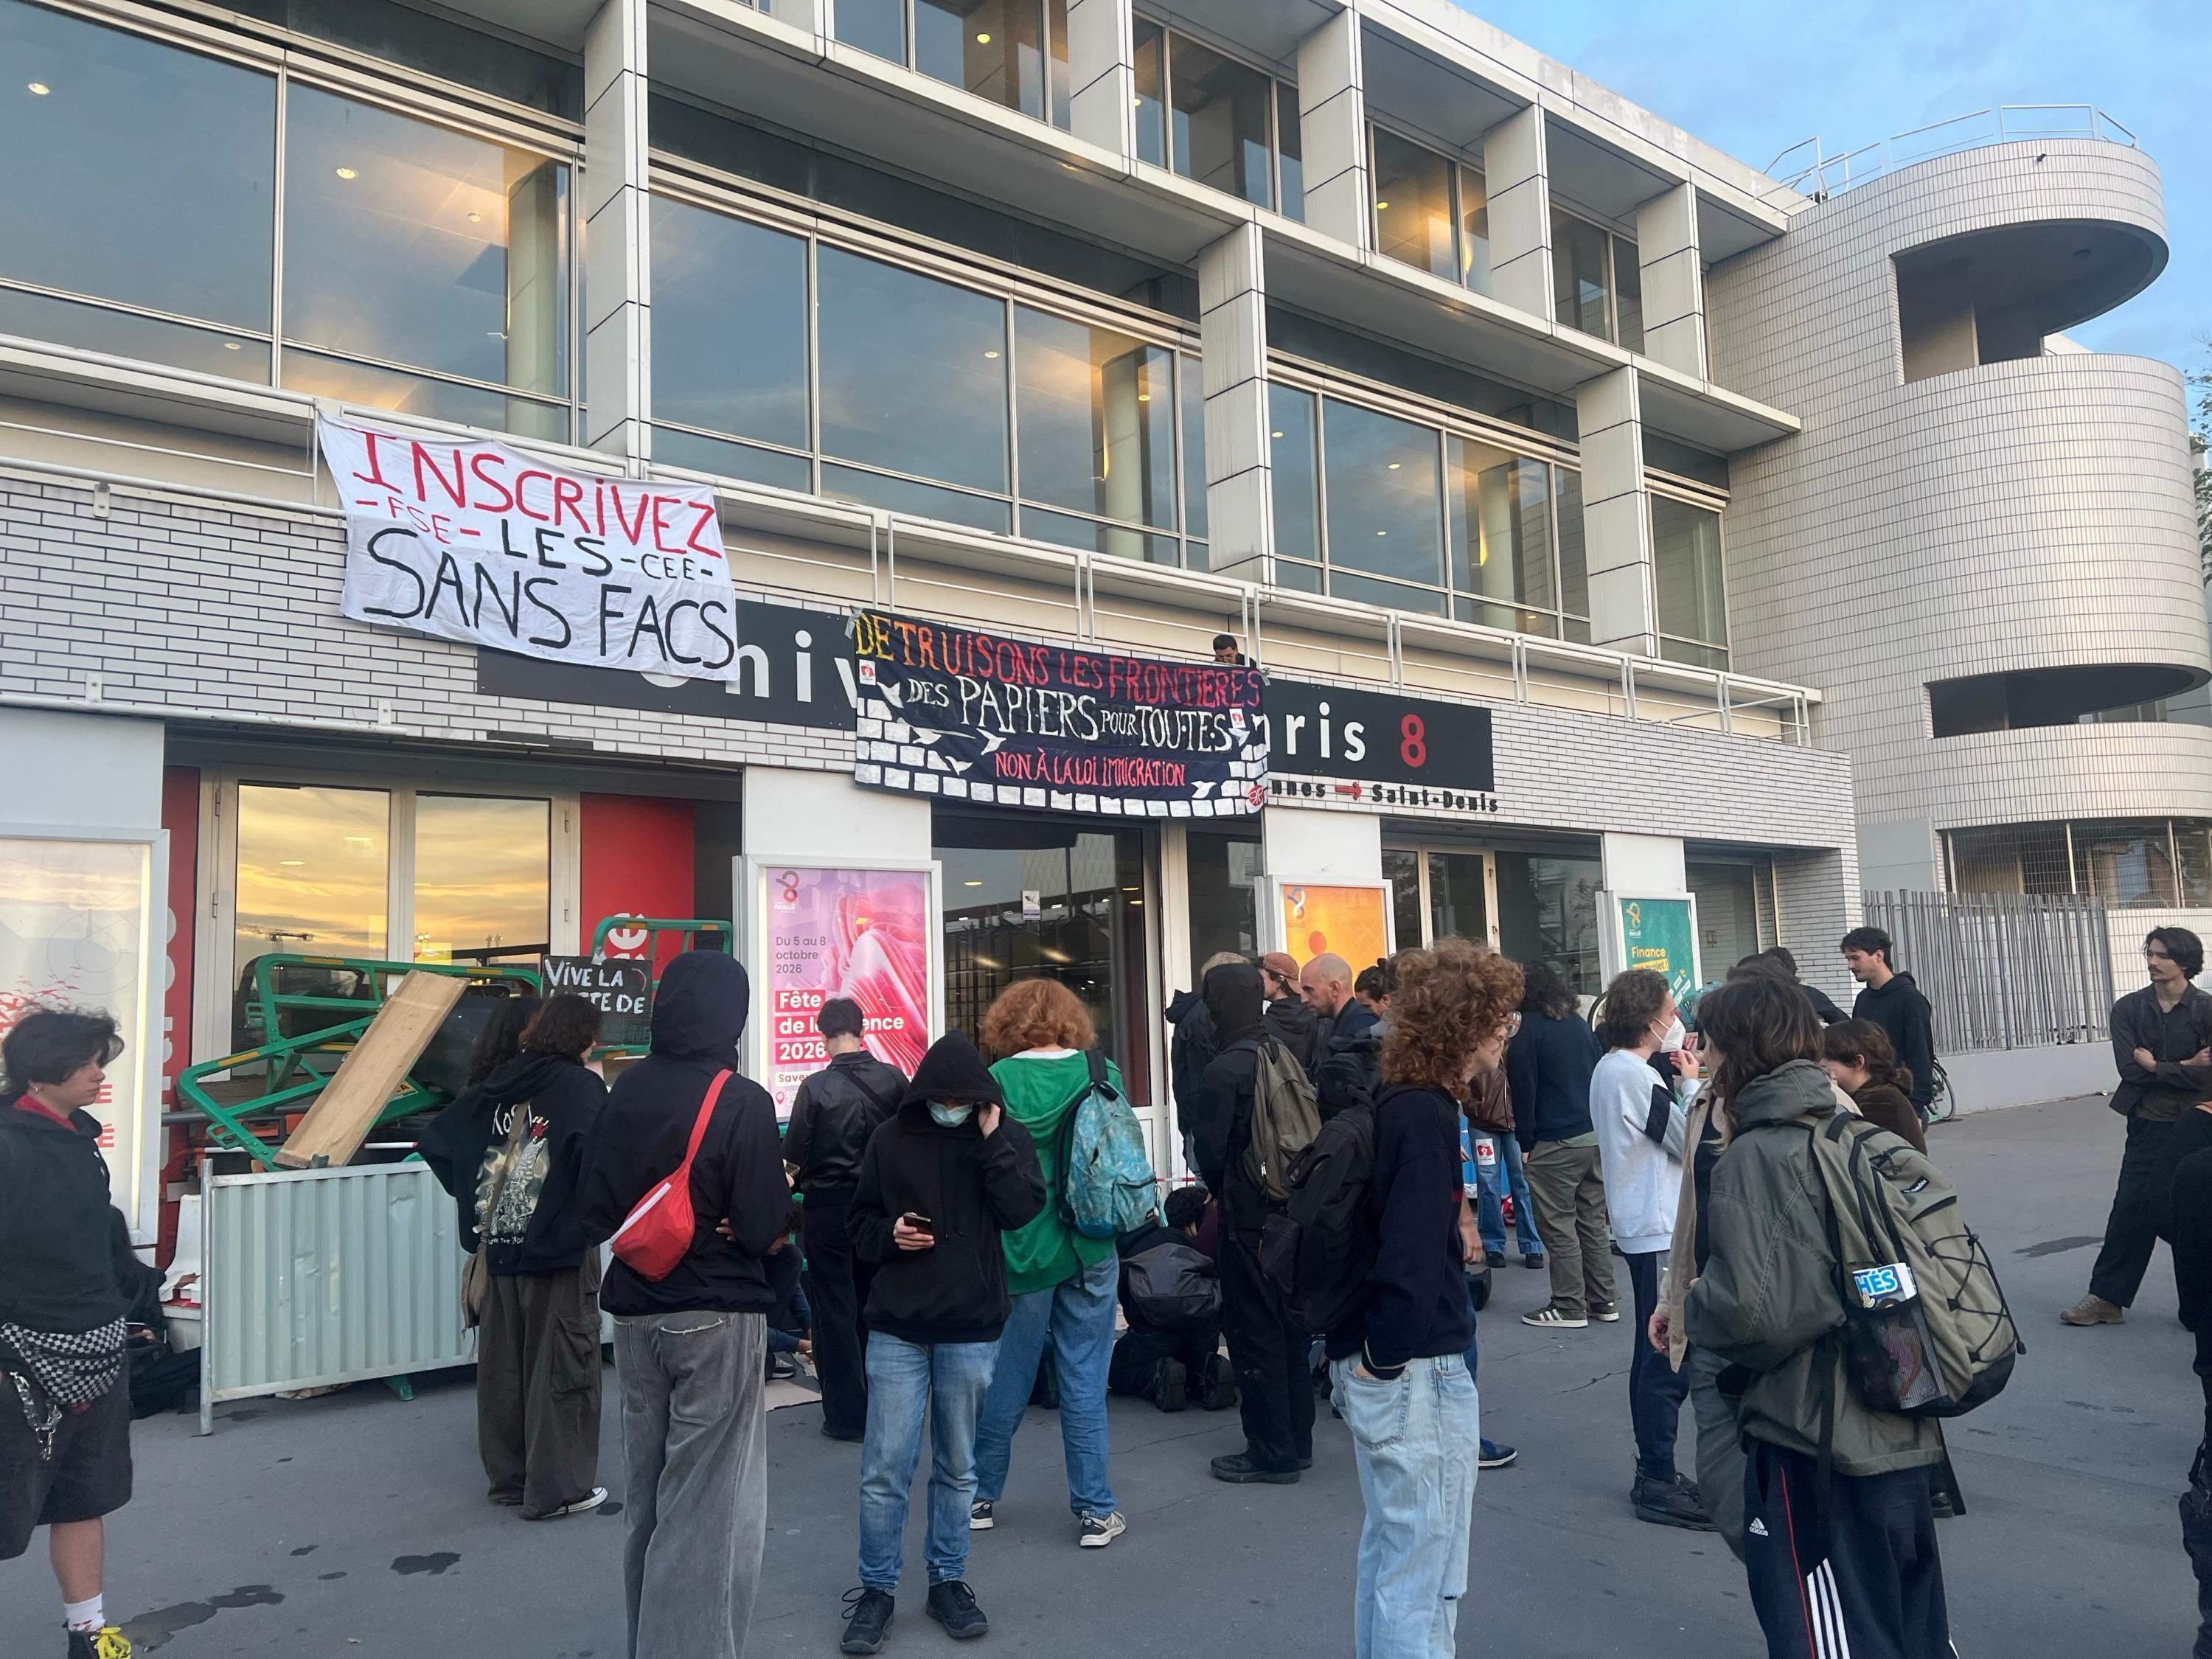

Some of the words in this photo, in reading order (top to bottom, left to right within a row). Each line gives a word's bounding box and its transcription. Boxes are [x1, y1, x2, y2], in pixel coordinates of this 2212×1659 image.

[501, 519, 613, 576] LES
[364, 527, 571, 650] SANS
[600, 584, 734, 669] FACS
[1060, 652, 1103, 690] LES
[906, 678, 950, 707] DES
[955, 675, 1099, 741] PAPIERS
[1101, 710, 1138, 737] POUR
[1401, 714, 1427, 768] 8
[995, 751, 1033, 780] NON
[1034, 746, 1051, 782] À
[1371, 784, 1498, 812] Saint-Denis
[776, 936, 791, 946] Du
[793, 936, 800, 946] 5
[804, 938, 817, 946] au
[819, 936, 827, 946] 8
[776, 950, 818, 960] octobre
[1632, 945, 1666, 958] Finance
[598, 968, 624, 987] LA
[776, 964, 802, 974] 2026
[616, 994, 646, 1015] DE
[779, 991, 821, 1009] Fête
[779, 1018, 804, 1034] de
[862, 1016, 905, 1031] ence
[779, 1043, 827, 1061] 2026
[779, 1074, 808, 1083] Save
